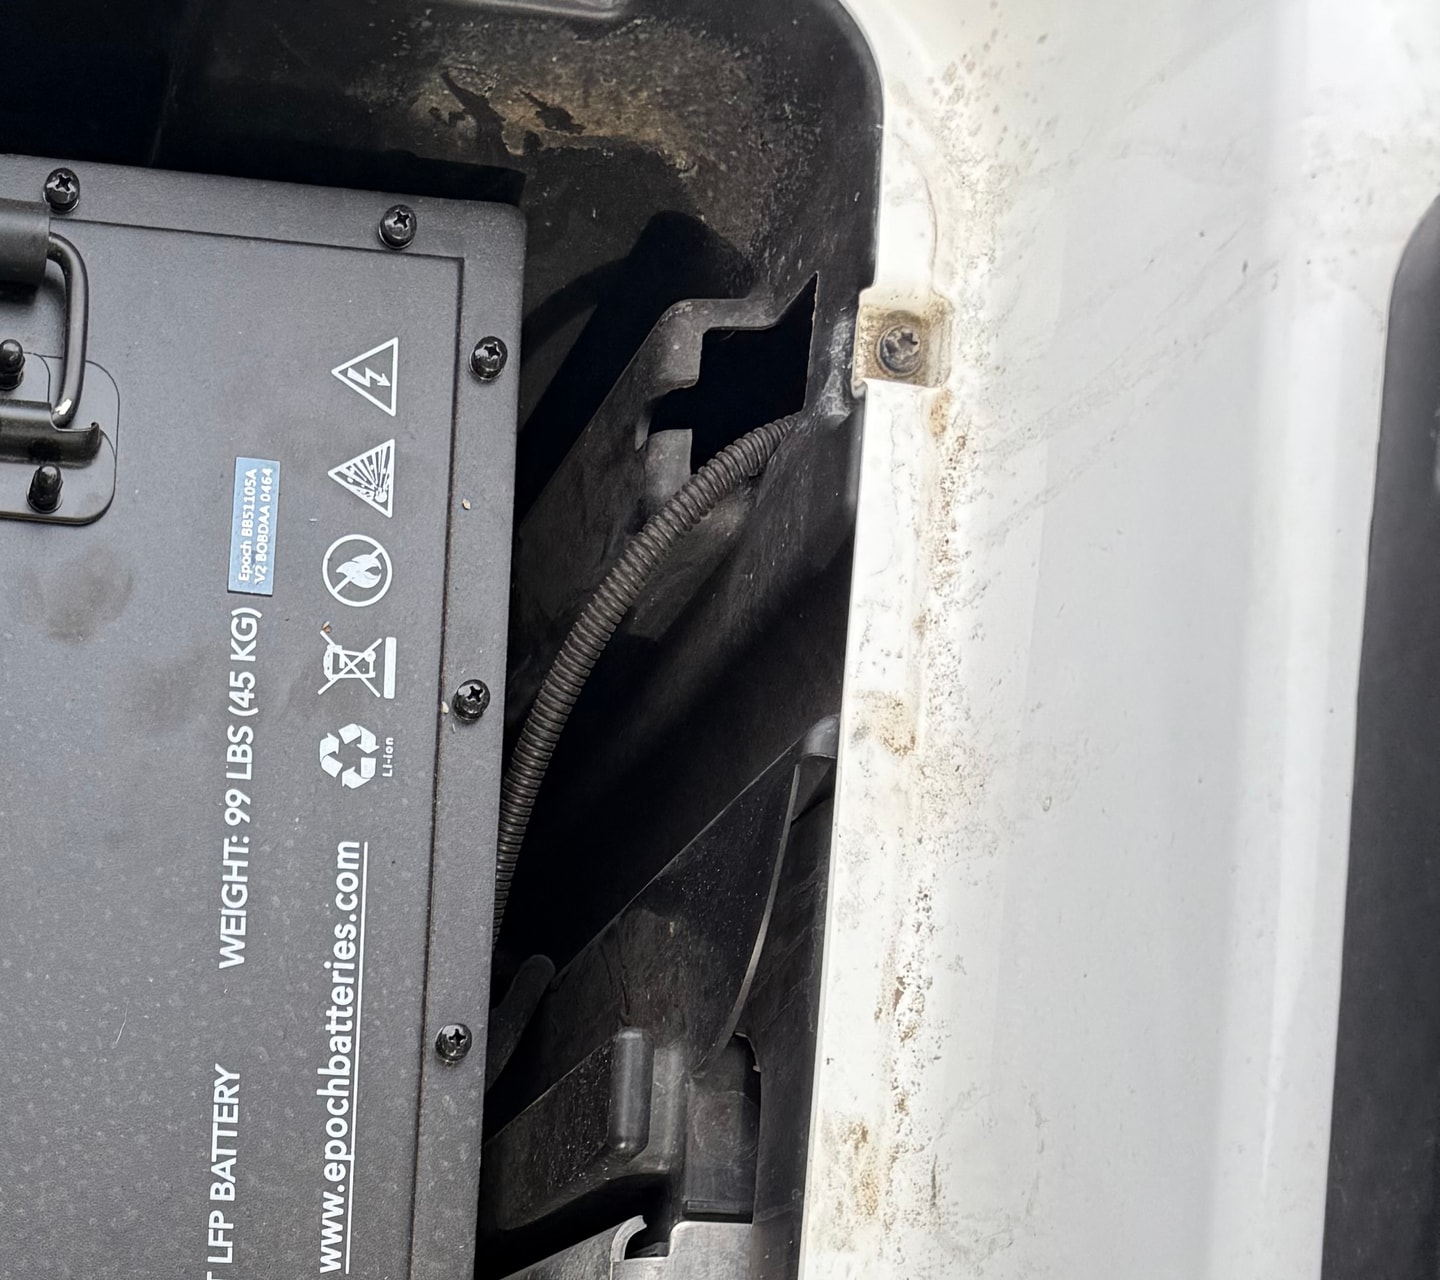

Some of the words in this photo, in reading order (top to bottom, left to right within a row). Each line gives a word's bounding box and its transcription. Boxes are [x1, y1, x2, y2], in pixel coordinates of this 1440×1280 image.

[241, 469, 257, 537] BB51105A
[260, 468, 273, 502] 0464
[238, 541, 252, 581] Epoch
[254, 564, 268, 584] V2
[230, 607, 262, 661] KG)
[228, 671, 260, 716] (45
[226, 724, 254, 780] LBS
[382, 736, 394, 777] Li-ion
[224, 789, 251, 826] 99
[218, 835, 250, 969] WEIGHT:
[317, 840, 362, 1274] www.epochbatteries.com
[209, 1064, 240, 1201] BATTERY
[207, 1210, 234, 1264] LFP
